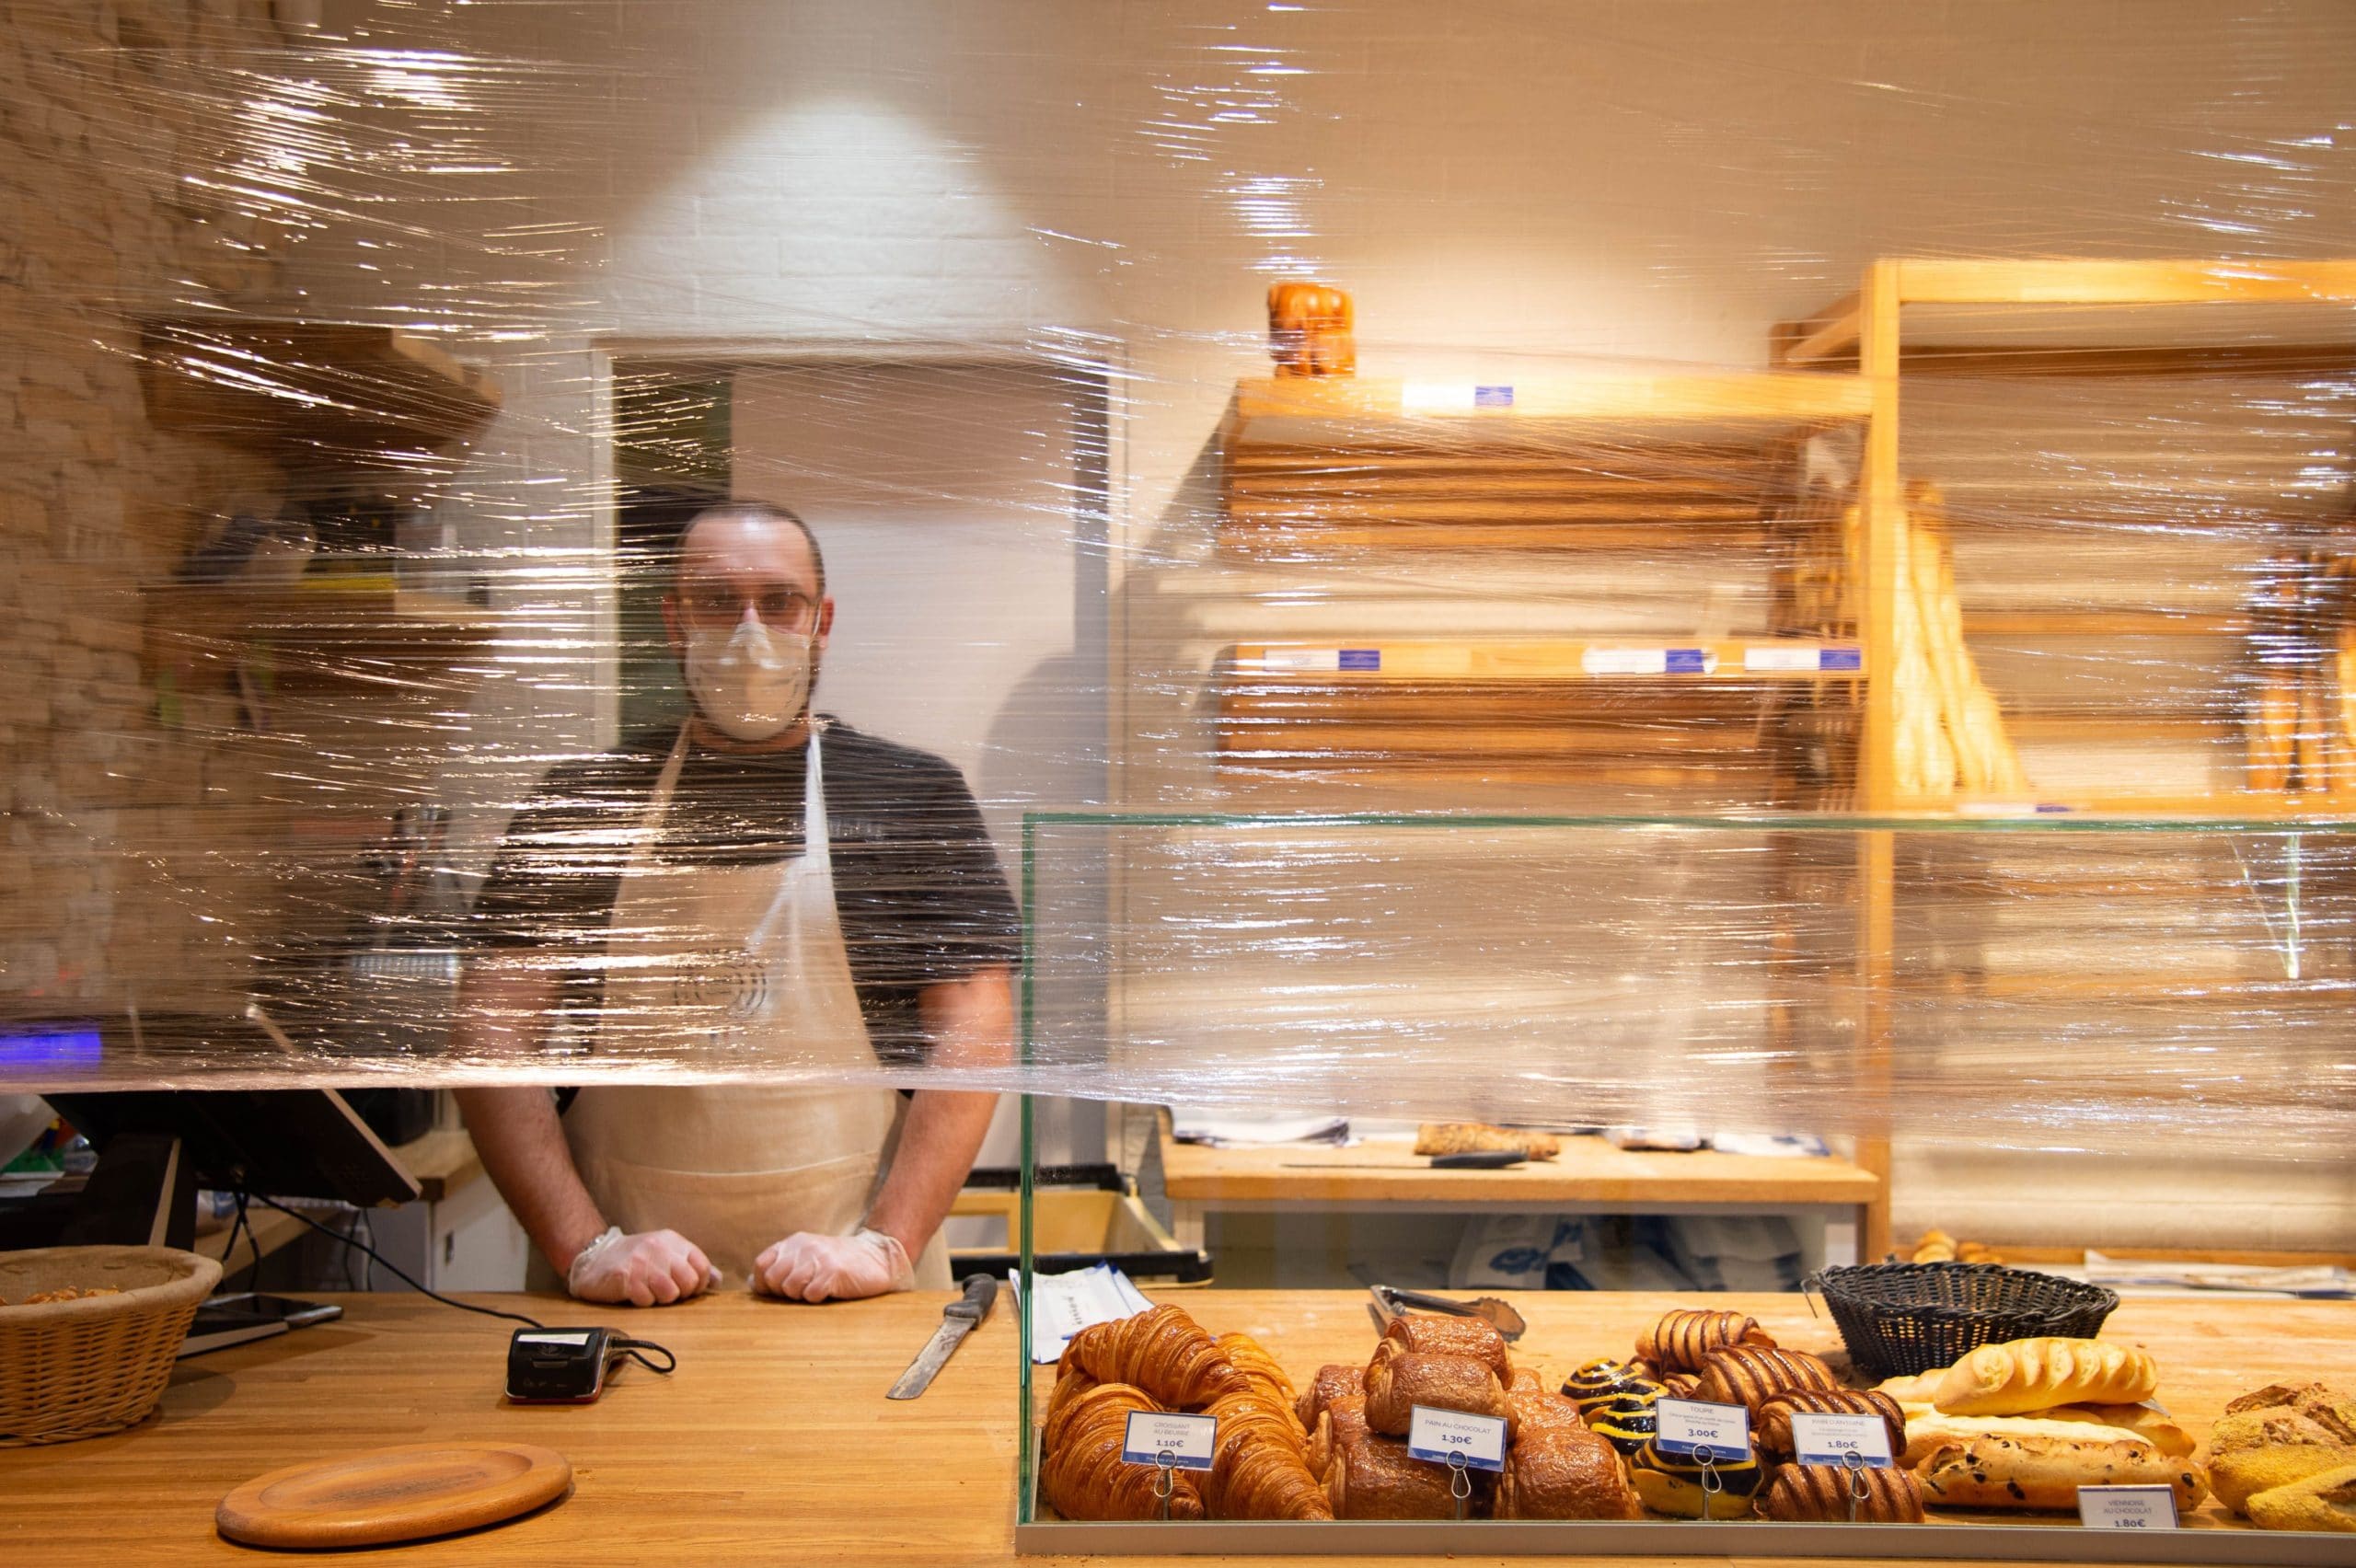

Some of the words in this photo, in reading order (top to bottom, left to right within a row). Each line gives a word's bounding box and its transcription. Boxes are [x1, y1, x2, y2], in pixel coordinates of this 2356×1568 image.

[1425, 1419, 1441, 1427] PAIN
[1453, 1424, 1492, 1435] CHOCOLAT
[1688, 1428, 1718, 1438] 3.00€
[1156, 1439, 1184, 1447] 1.10€
[1441, 1434, 1472, 1445] 1.30€
[1827, 1440, 1858, 1449] 1.80€
[2115, 1518, 2146, 1528] 1.80€
